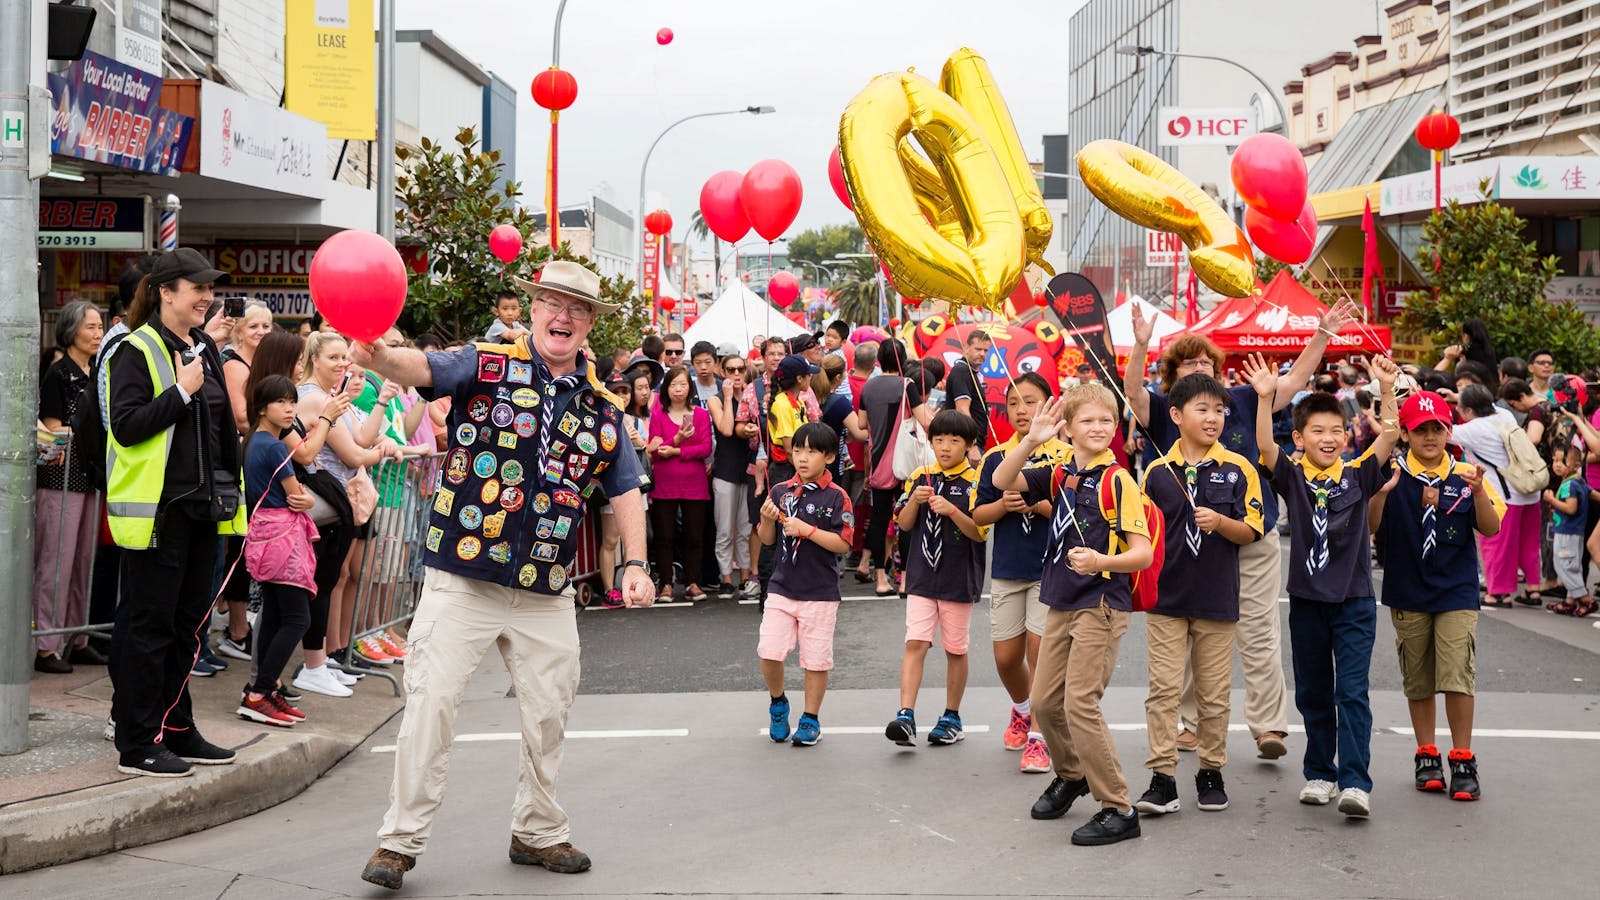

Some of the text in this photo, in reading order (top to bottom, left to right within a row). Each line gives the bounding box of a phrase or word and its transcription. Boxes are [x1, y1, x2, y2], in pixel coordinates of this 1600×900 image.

[317, 33, 347, 49] LEASE
[82, 59, 151, 102] Your Local Barber
[5, 118, 21, 141] H
[79, 101, 152, 160] BARBER
[1197, 119, 1248, 136] HCF
[64, 236, 97, 246] 3913
[291, 276, 309, 284] VAL
[1070, 294, 1095, 308] SBS
